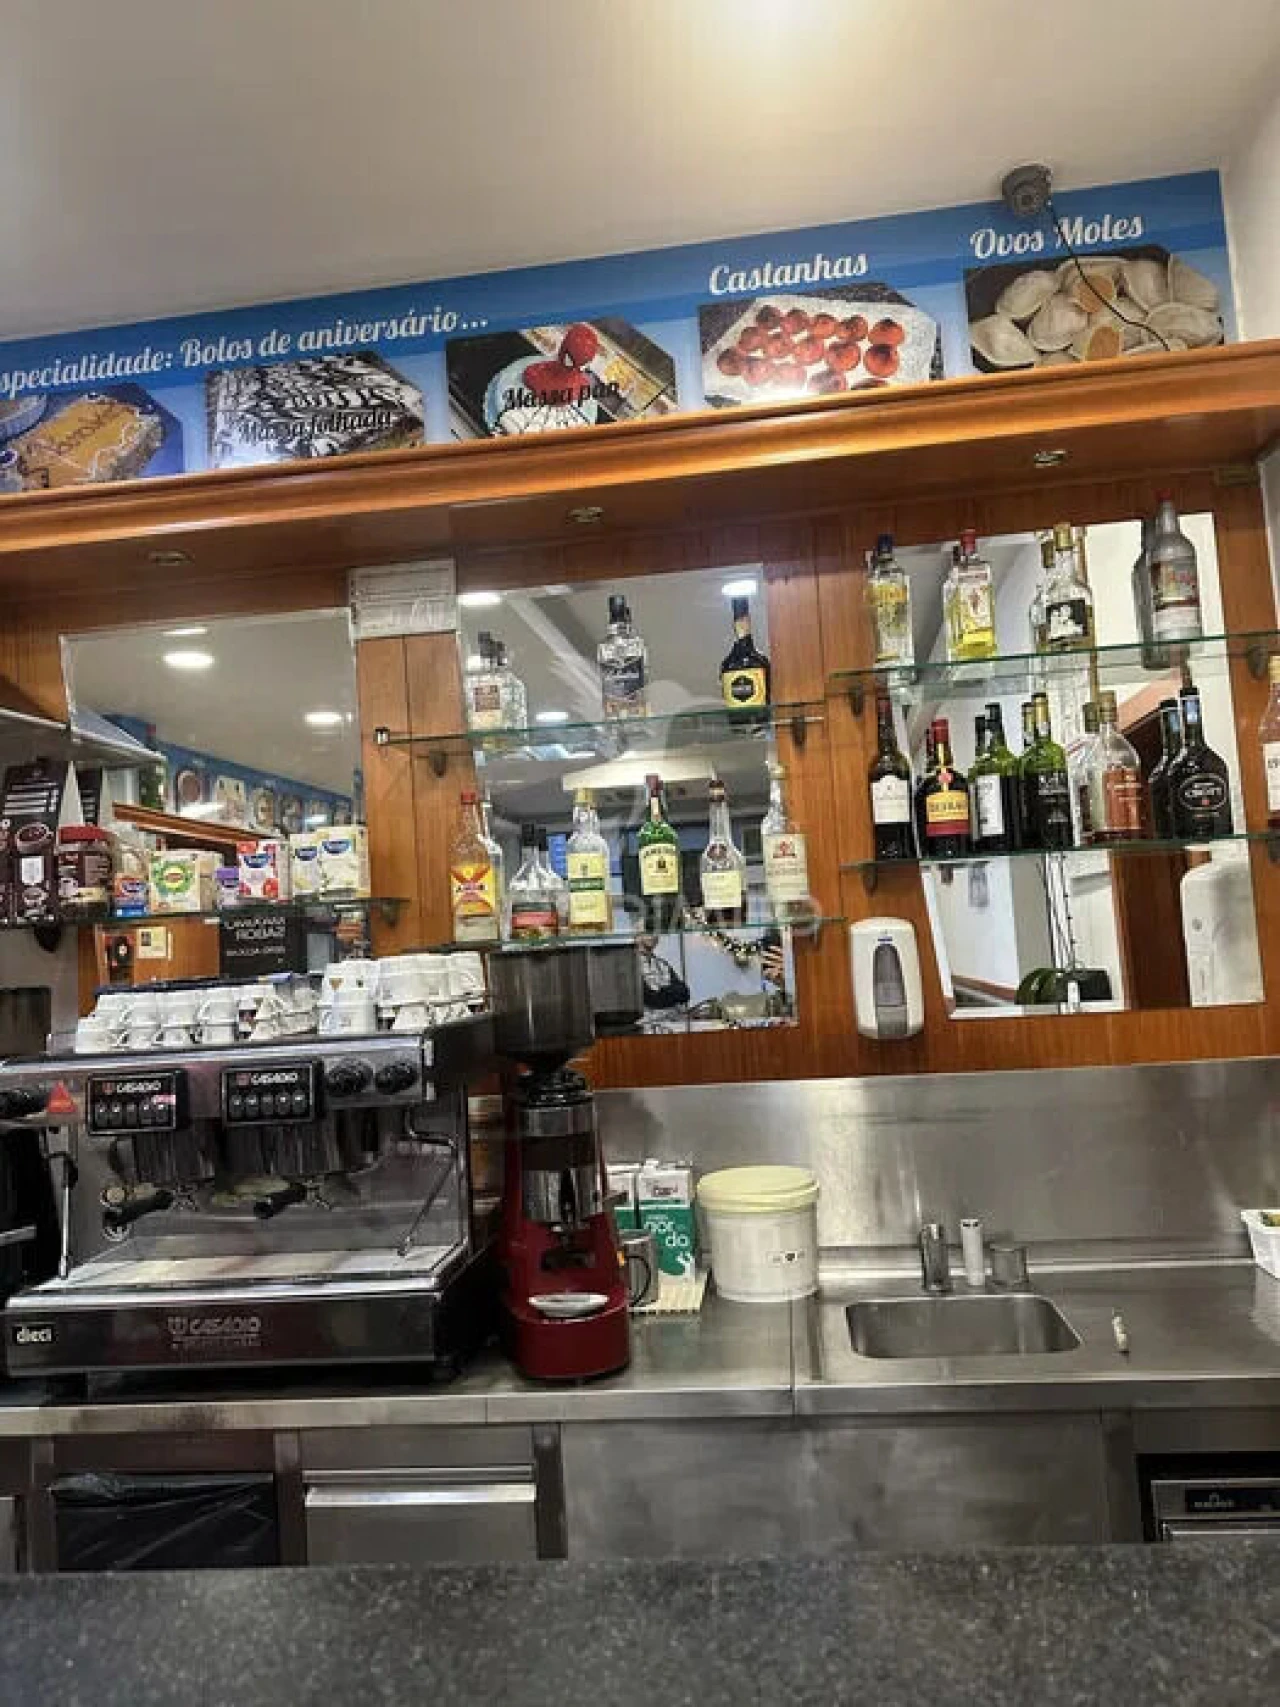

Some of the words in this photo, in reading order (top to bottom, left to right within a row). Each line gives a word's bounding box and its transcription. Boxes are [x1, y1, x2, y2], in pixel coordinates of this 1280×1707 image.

[968, 227, 1044, 259] Ovos
[1055, 213, 1143, 248] Moles
[708, 252, 869, 296] Castanhas
[180, 338, 252, 366] Bolos
[257, 327, 291, 358] de
